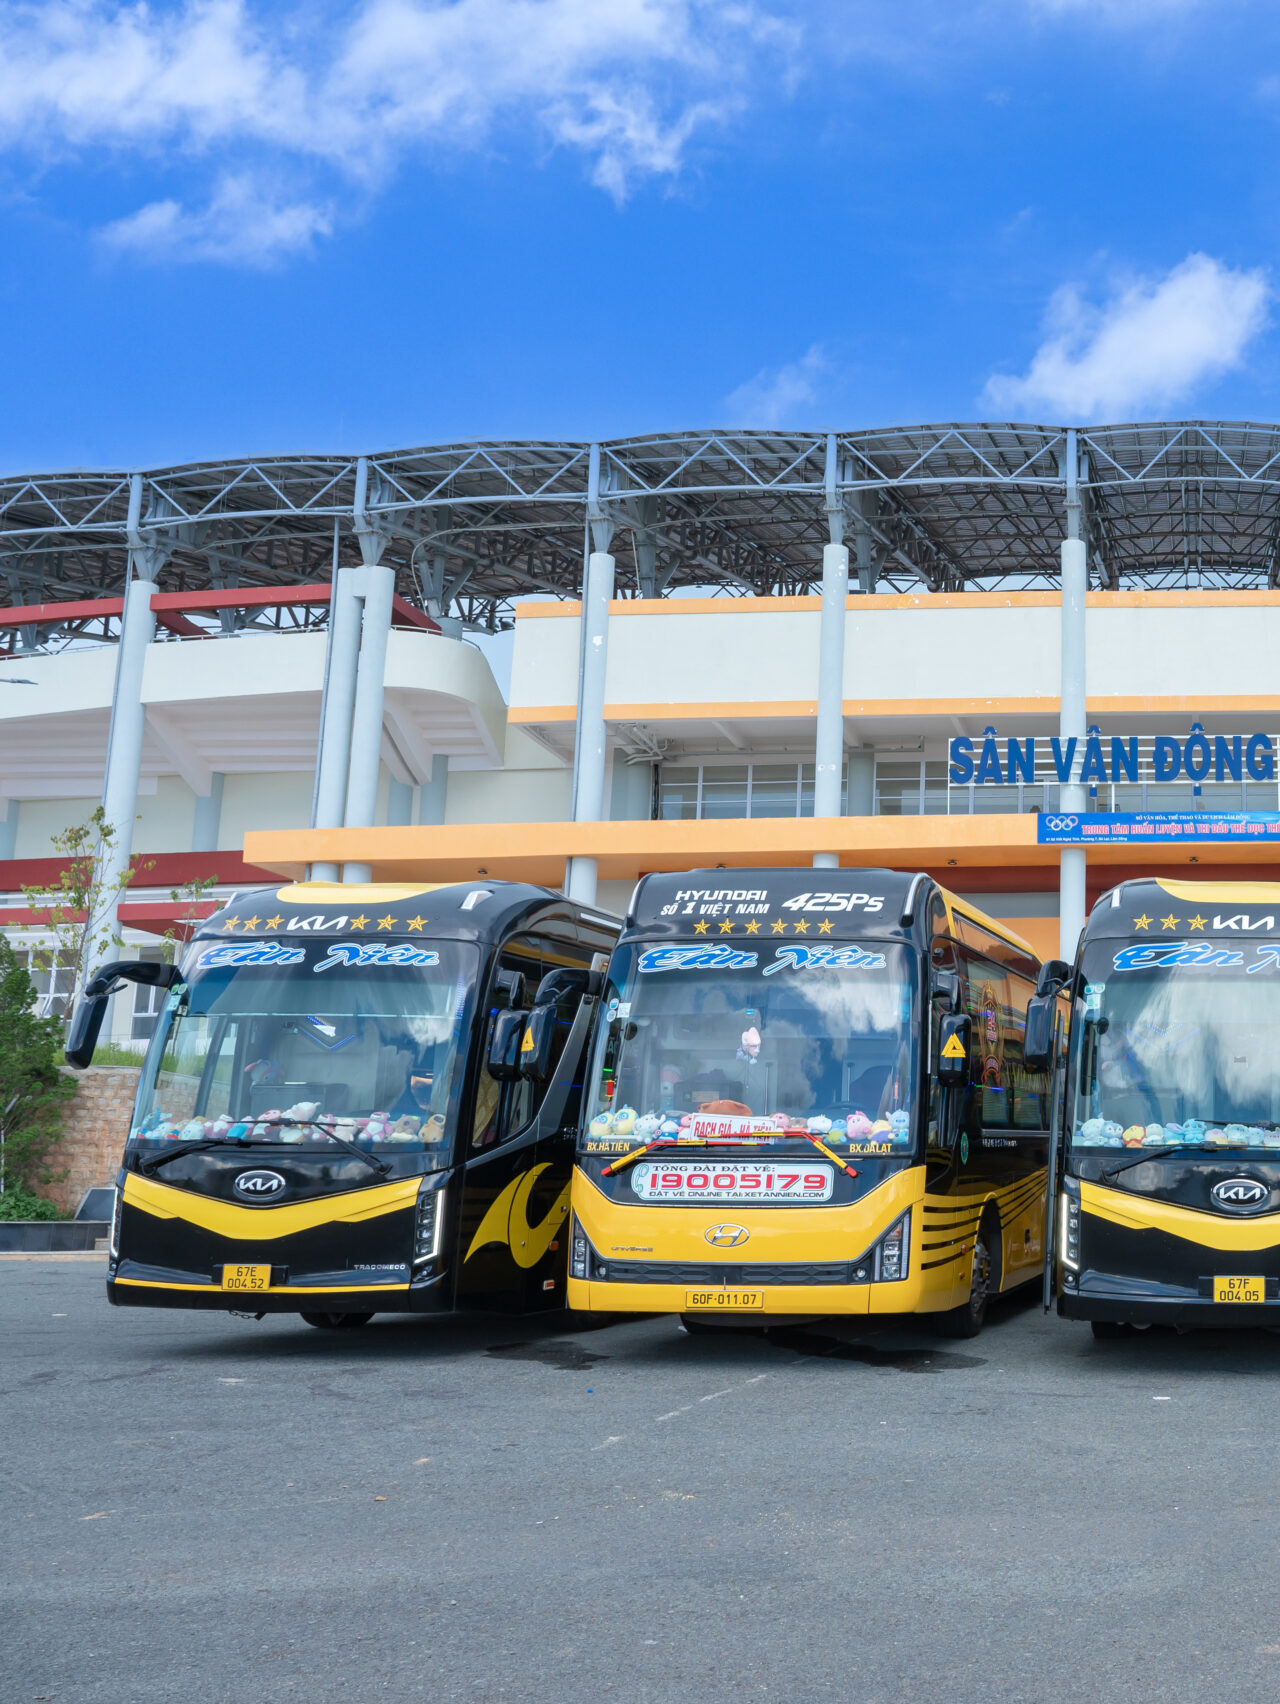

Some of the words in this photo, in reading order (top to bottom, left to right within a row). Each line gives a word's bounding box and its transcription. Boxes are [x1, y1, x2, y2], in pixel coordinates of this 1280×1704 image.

[949, 725, 1035, 784] SÂN
[1050, 724, 1138, 797] VẬN
[1152, 722, 1275, 796] ĐỘNG
[1081, 824, 1110, 835] TRUNG
[1111, 823, 1130, 835] TÂM
[1130, 821, 1154, 834] HUẤN
[1155, 822, 1182, 836] LUYỆN
[1183, 822, 1195, 834] VÀ
[1196, 823, 1210, 834] THI
[675, 890, 767, 901] HYUNDAI
[660, 900, 678, 915] SỐ
[682, 902, 694, 914] 1
[699, 903, 733, 917] VIỆT
[735, 903, 770, 914] NAM
[287, 916, 349, 930] KIA
[1213, 914, 1275, 930] KIA
[611, 1140, 630, 1151] TIÊN
[653, 1164, 688, 1172] TỔNG
[239, 1178, 279, 1191] KIA
[650, 1173, 827, 1190] 19005179
[1219, 1187, 1261, 1200] KIA
[236, 1266, 257, 1277] 67E
[227, 1278, 264, 1289] 004.52
[1228, 1279, 1250, 1289] 67F
[1219, 1291, 1259, 1301] 004.05
